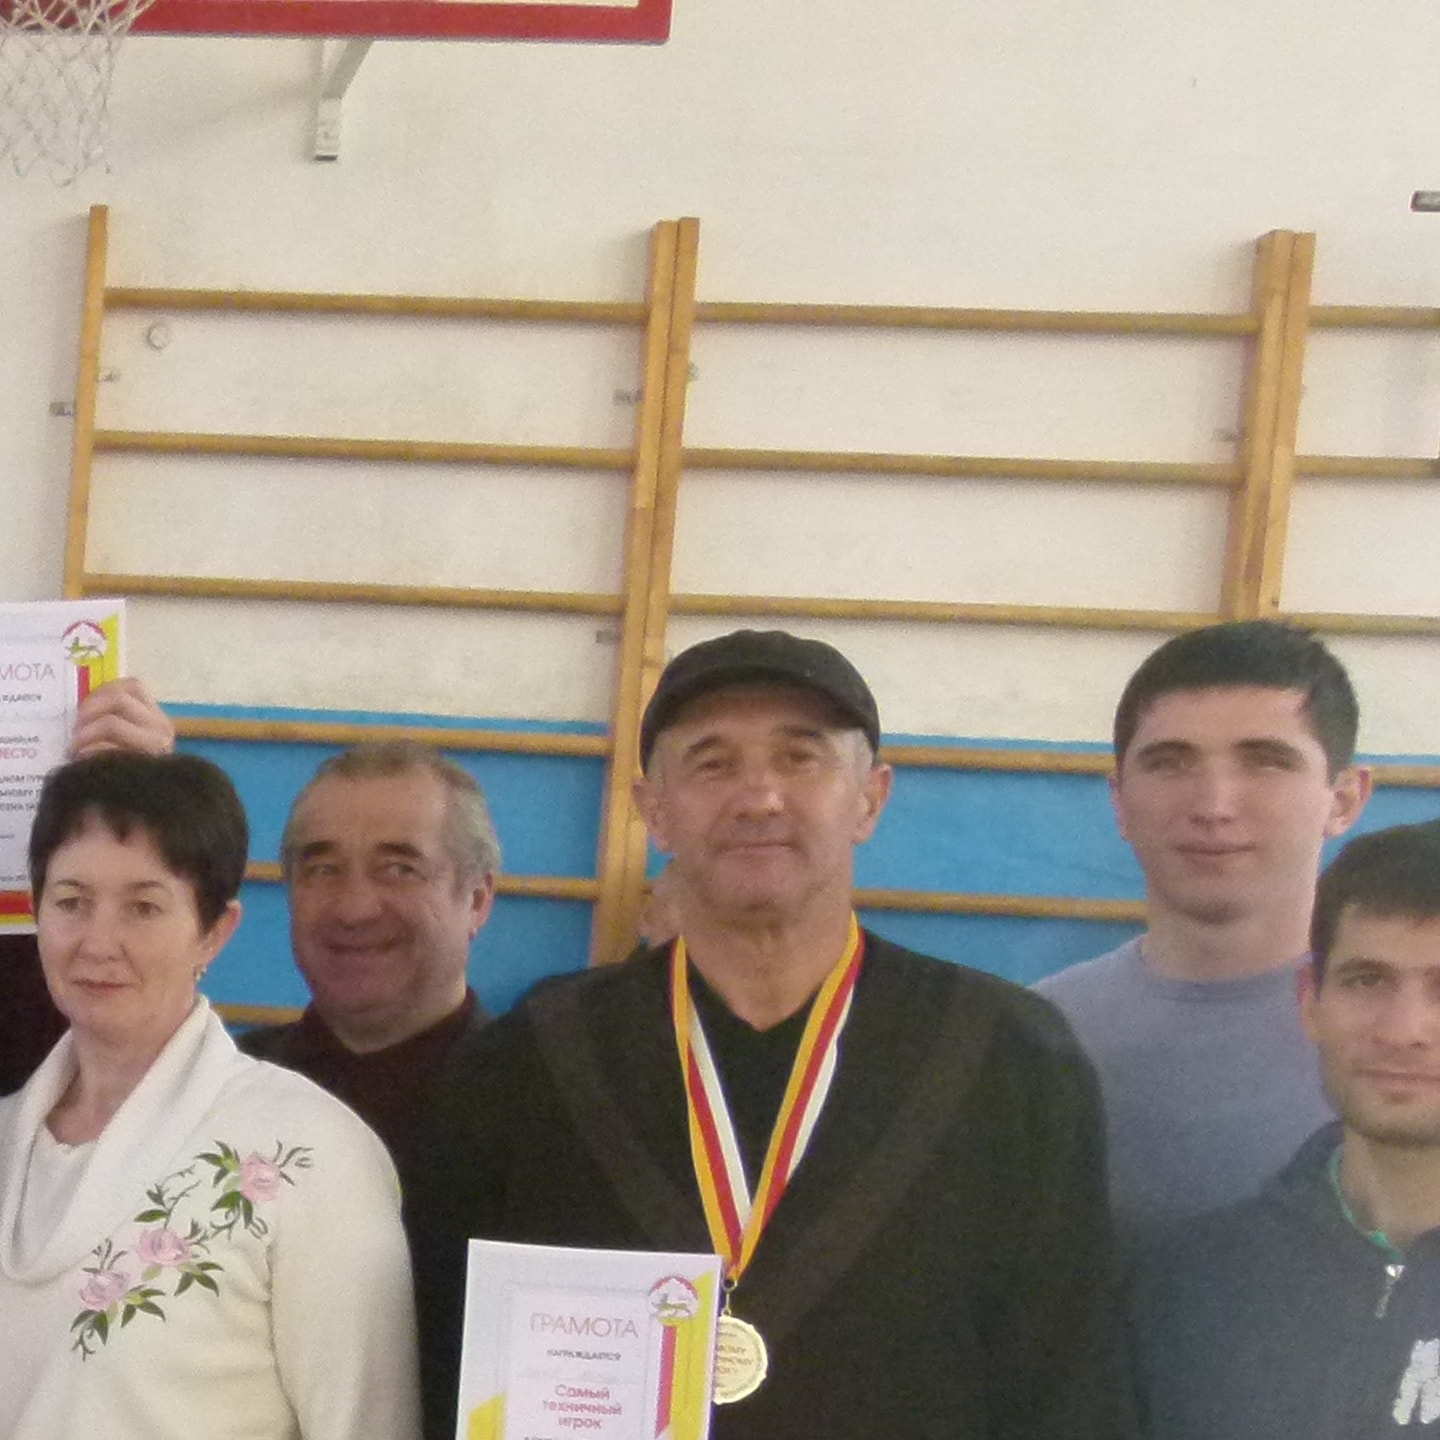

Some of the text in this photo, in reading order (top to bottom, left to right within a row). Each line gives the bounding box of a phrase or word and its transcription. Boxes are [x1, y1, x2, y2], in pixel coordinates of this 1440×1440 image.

[529, 1312, 639, 1338] ГРАМОТА
[555, 1384, 610, 1400] Самый
[558, 1417, 602, 1430] игрок
